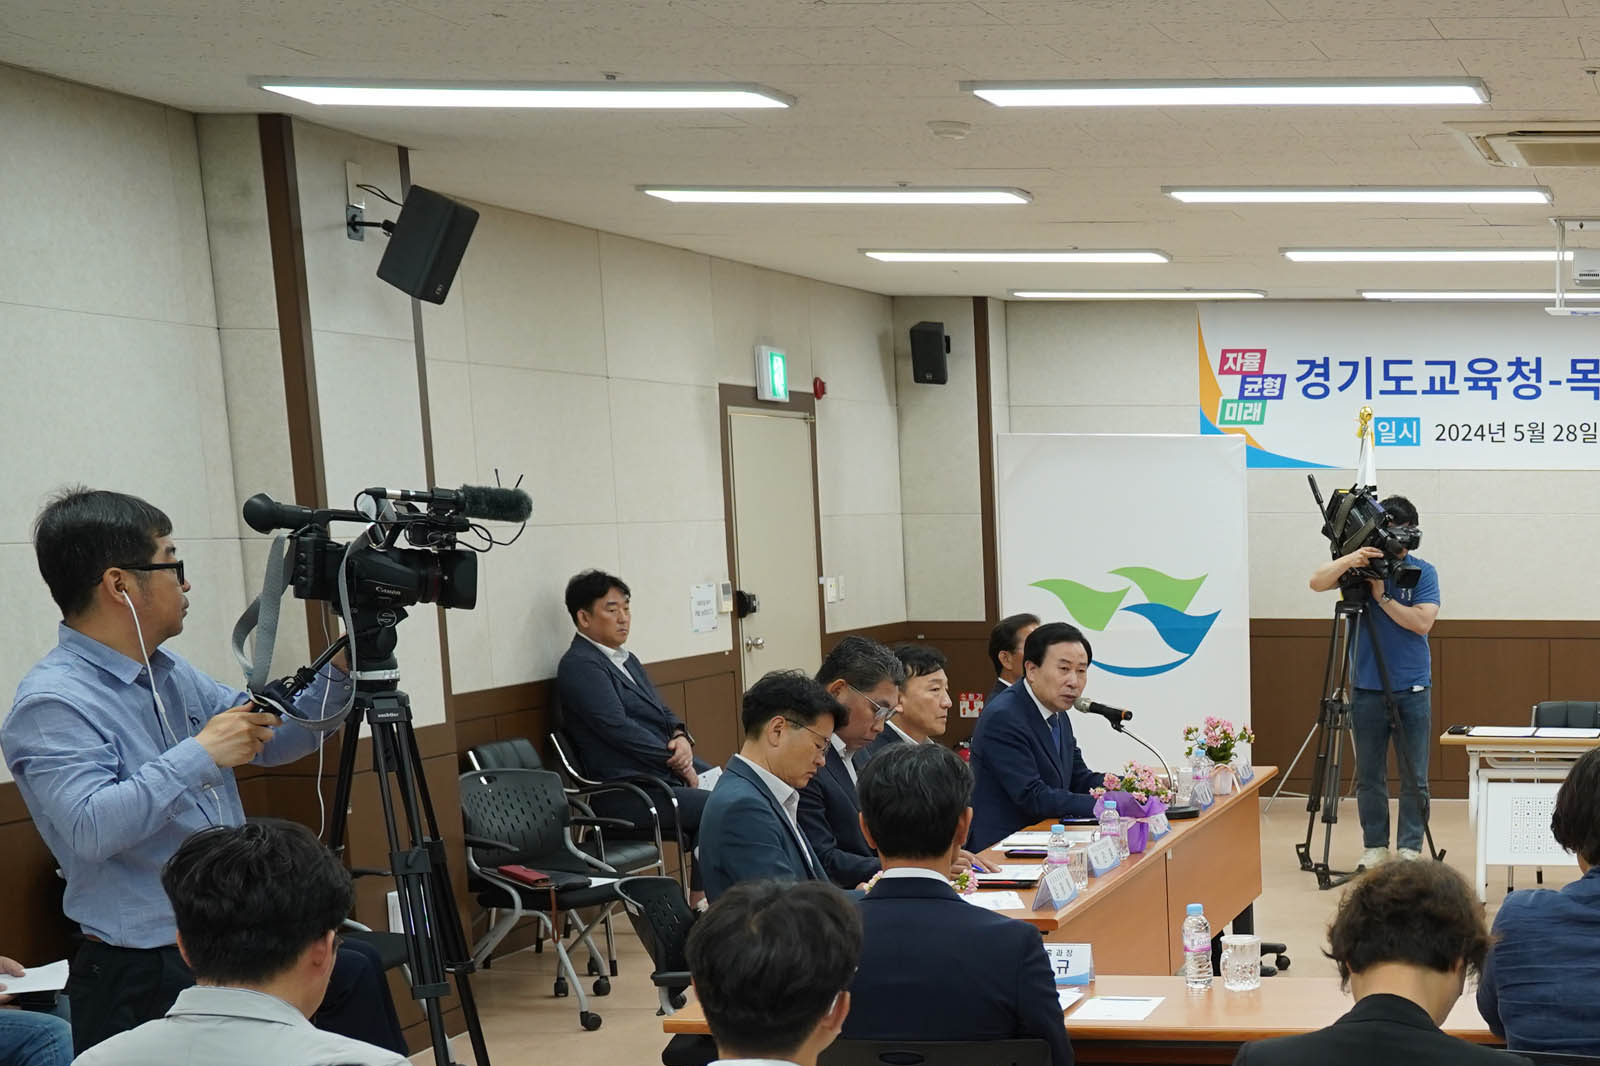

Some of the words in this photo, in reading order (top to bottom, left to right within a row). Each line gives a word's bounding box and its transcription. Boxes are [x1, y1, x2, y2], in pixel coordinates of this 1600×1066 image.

[1223, 351, 1262, 373] 자율
[1244, 376, 1283, 397] 균형
[1224, 401, 1263, 423] 미래
[1377, 421, 1418, 443] 일시
[1434, 422, 1506, 444] 2024년
[1513, 422, 1545, 444] 5월
[1552, 422, 1598, 444] 28일
